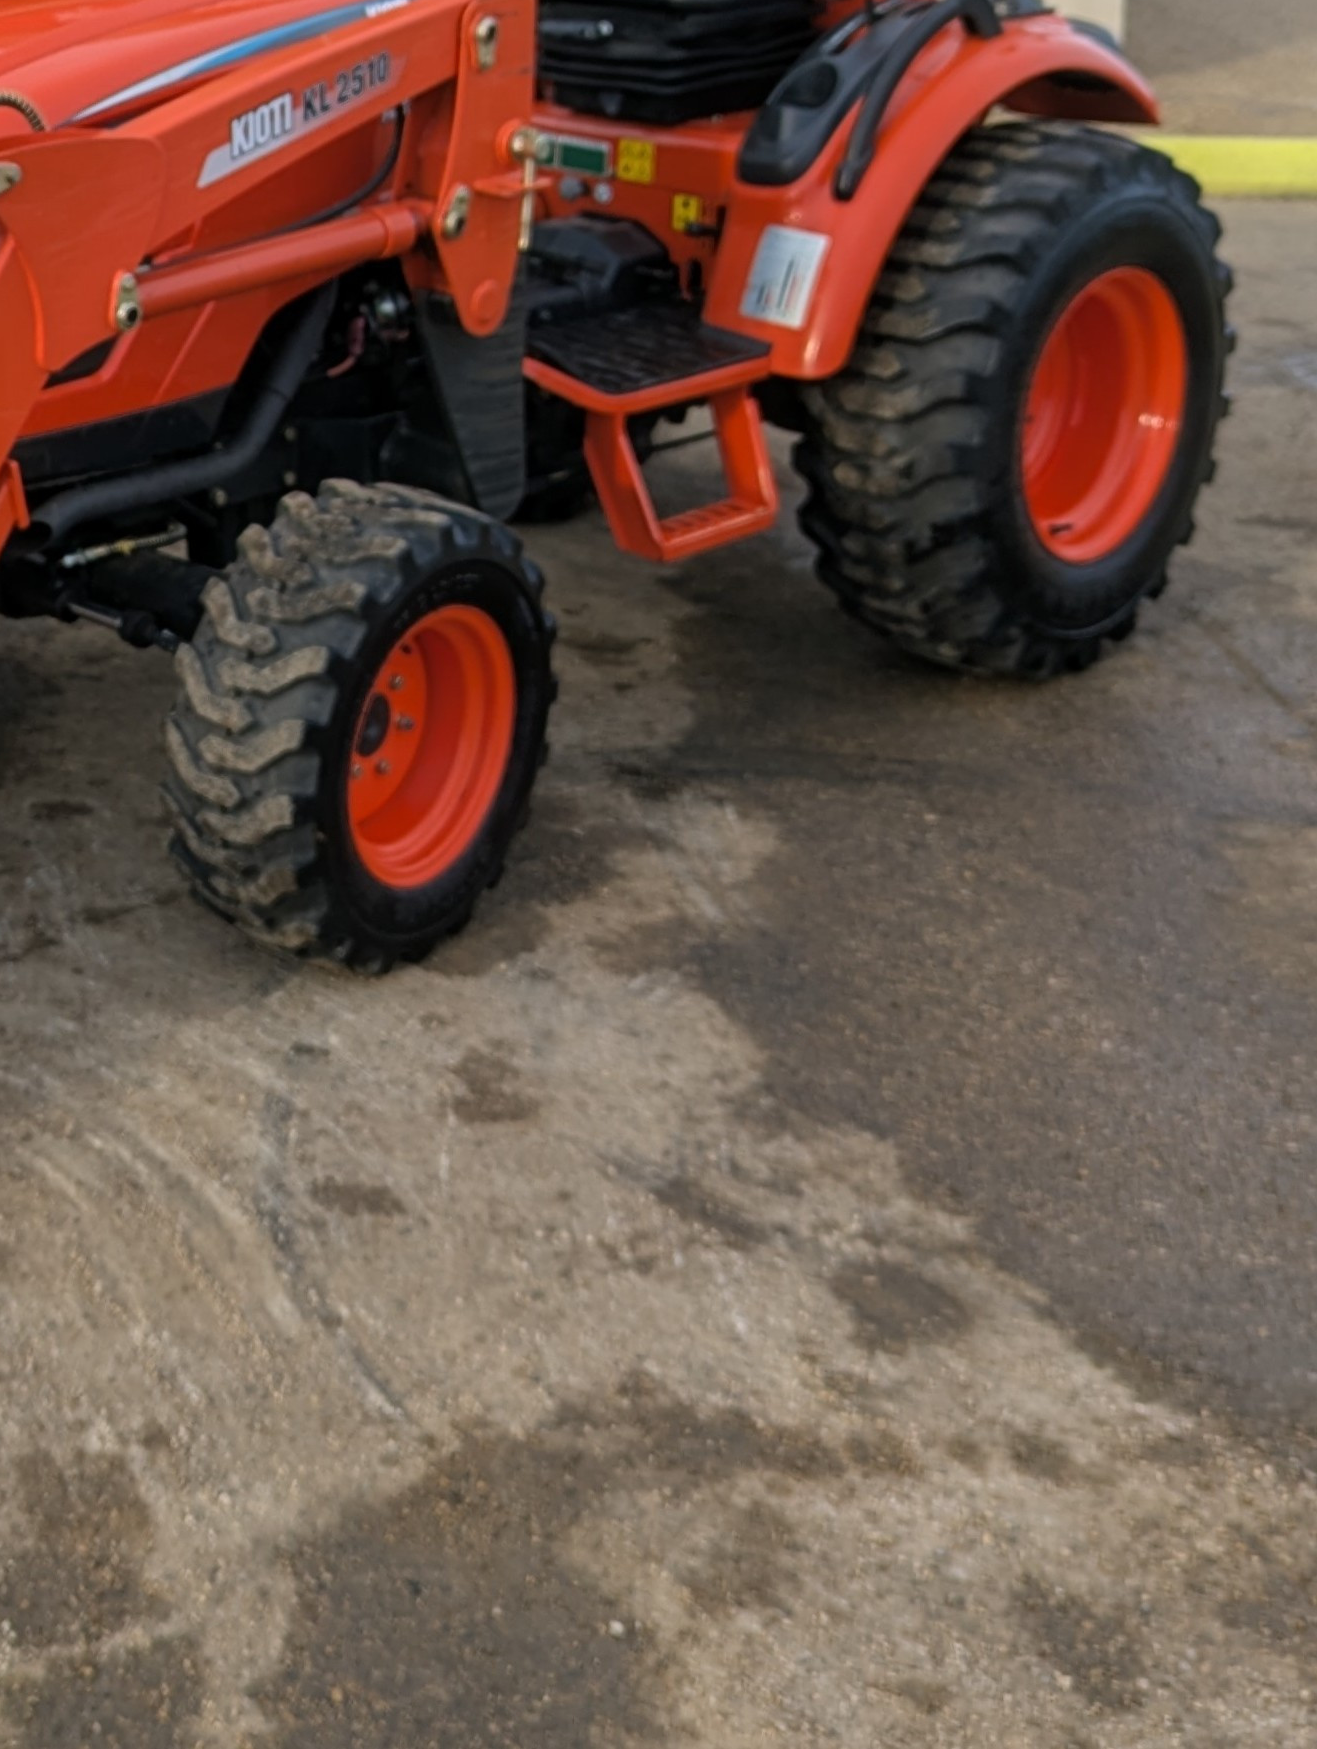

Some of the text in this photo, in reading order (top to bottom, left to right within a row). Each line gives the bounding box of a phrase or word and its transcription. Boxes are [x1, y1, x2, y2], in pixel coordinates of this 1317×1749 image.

[230, 92, 292, 158] KIOTI
[302, 81, 332, 122] KL
[336, 52, 390, 103] 2510
